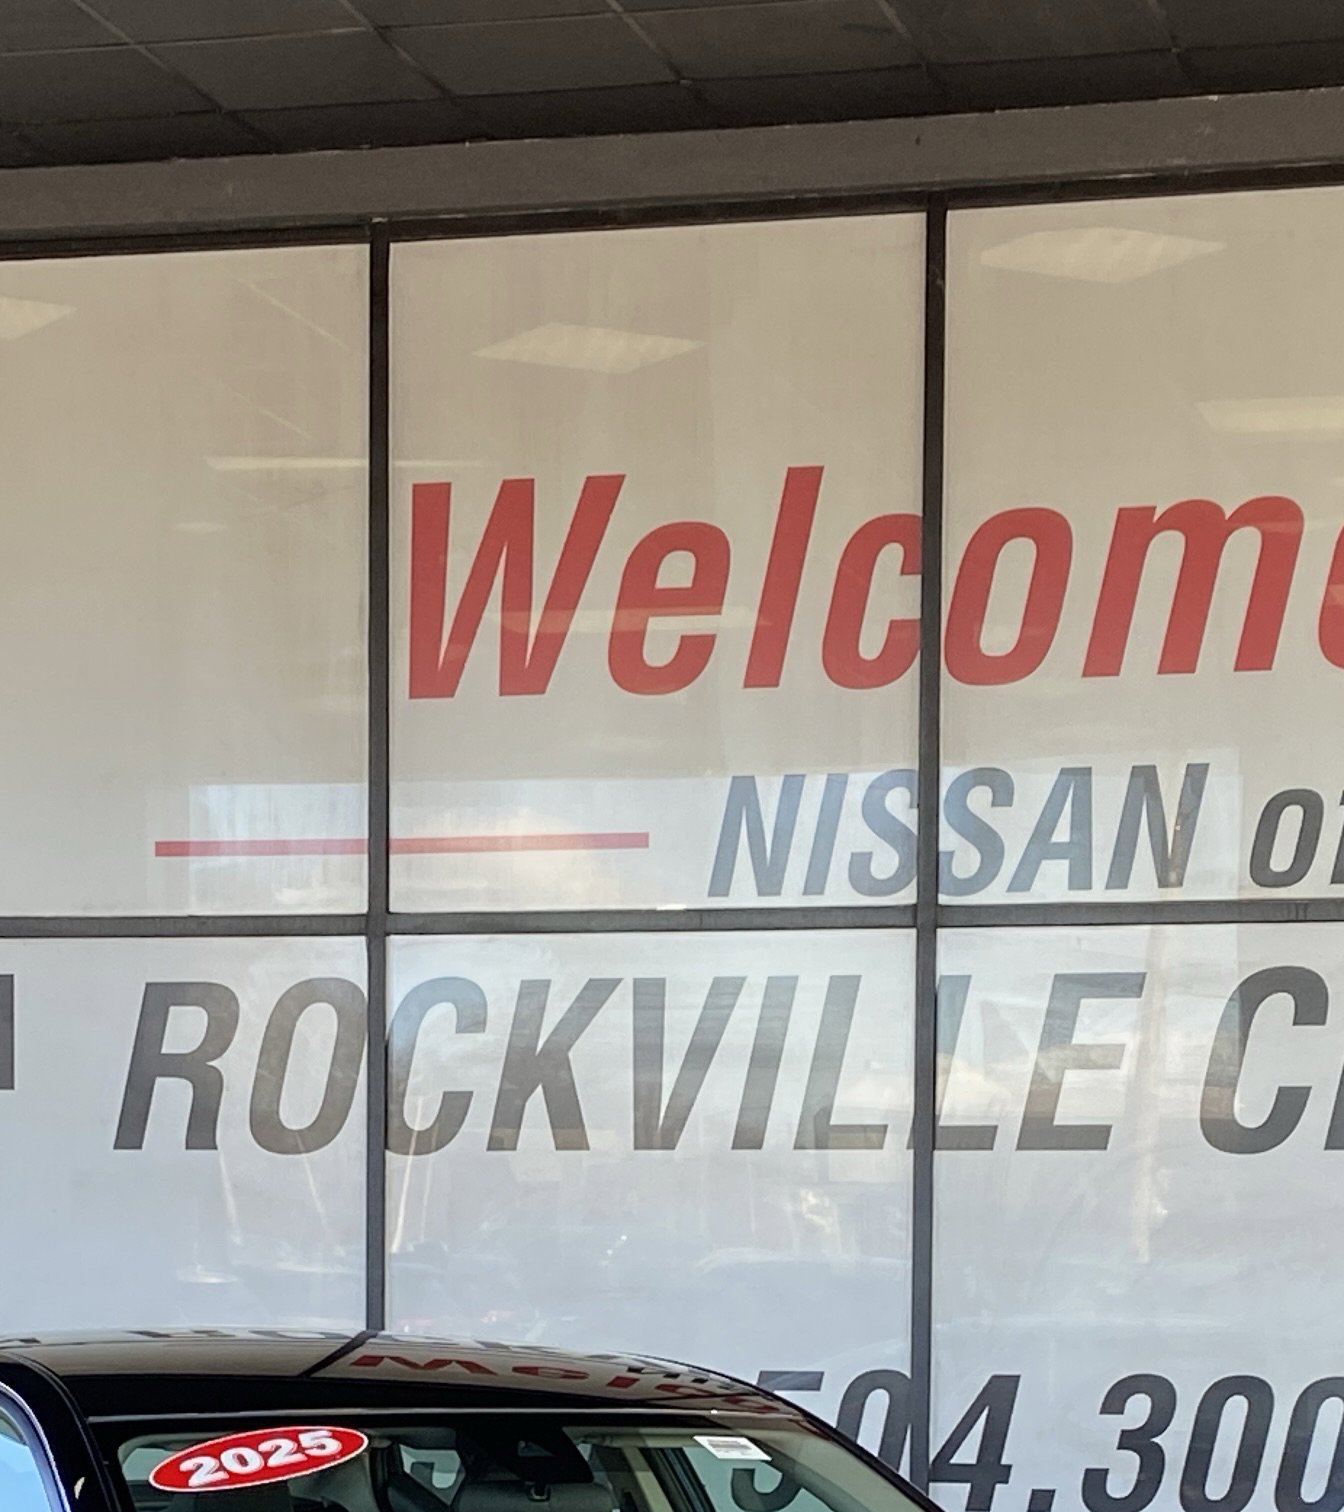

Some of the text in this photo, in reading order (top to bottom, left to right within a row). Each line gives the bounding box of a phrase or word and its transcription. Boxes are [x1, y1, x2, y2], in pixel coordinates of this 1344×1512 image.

[706, 762, 1211, 900] NISSAN
[112, 970, 1146, 1159] ROCKVILLE
[179, 1429, 343, 1488] 2025
